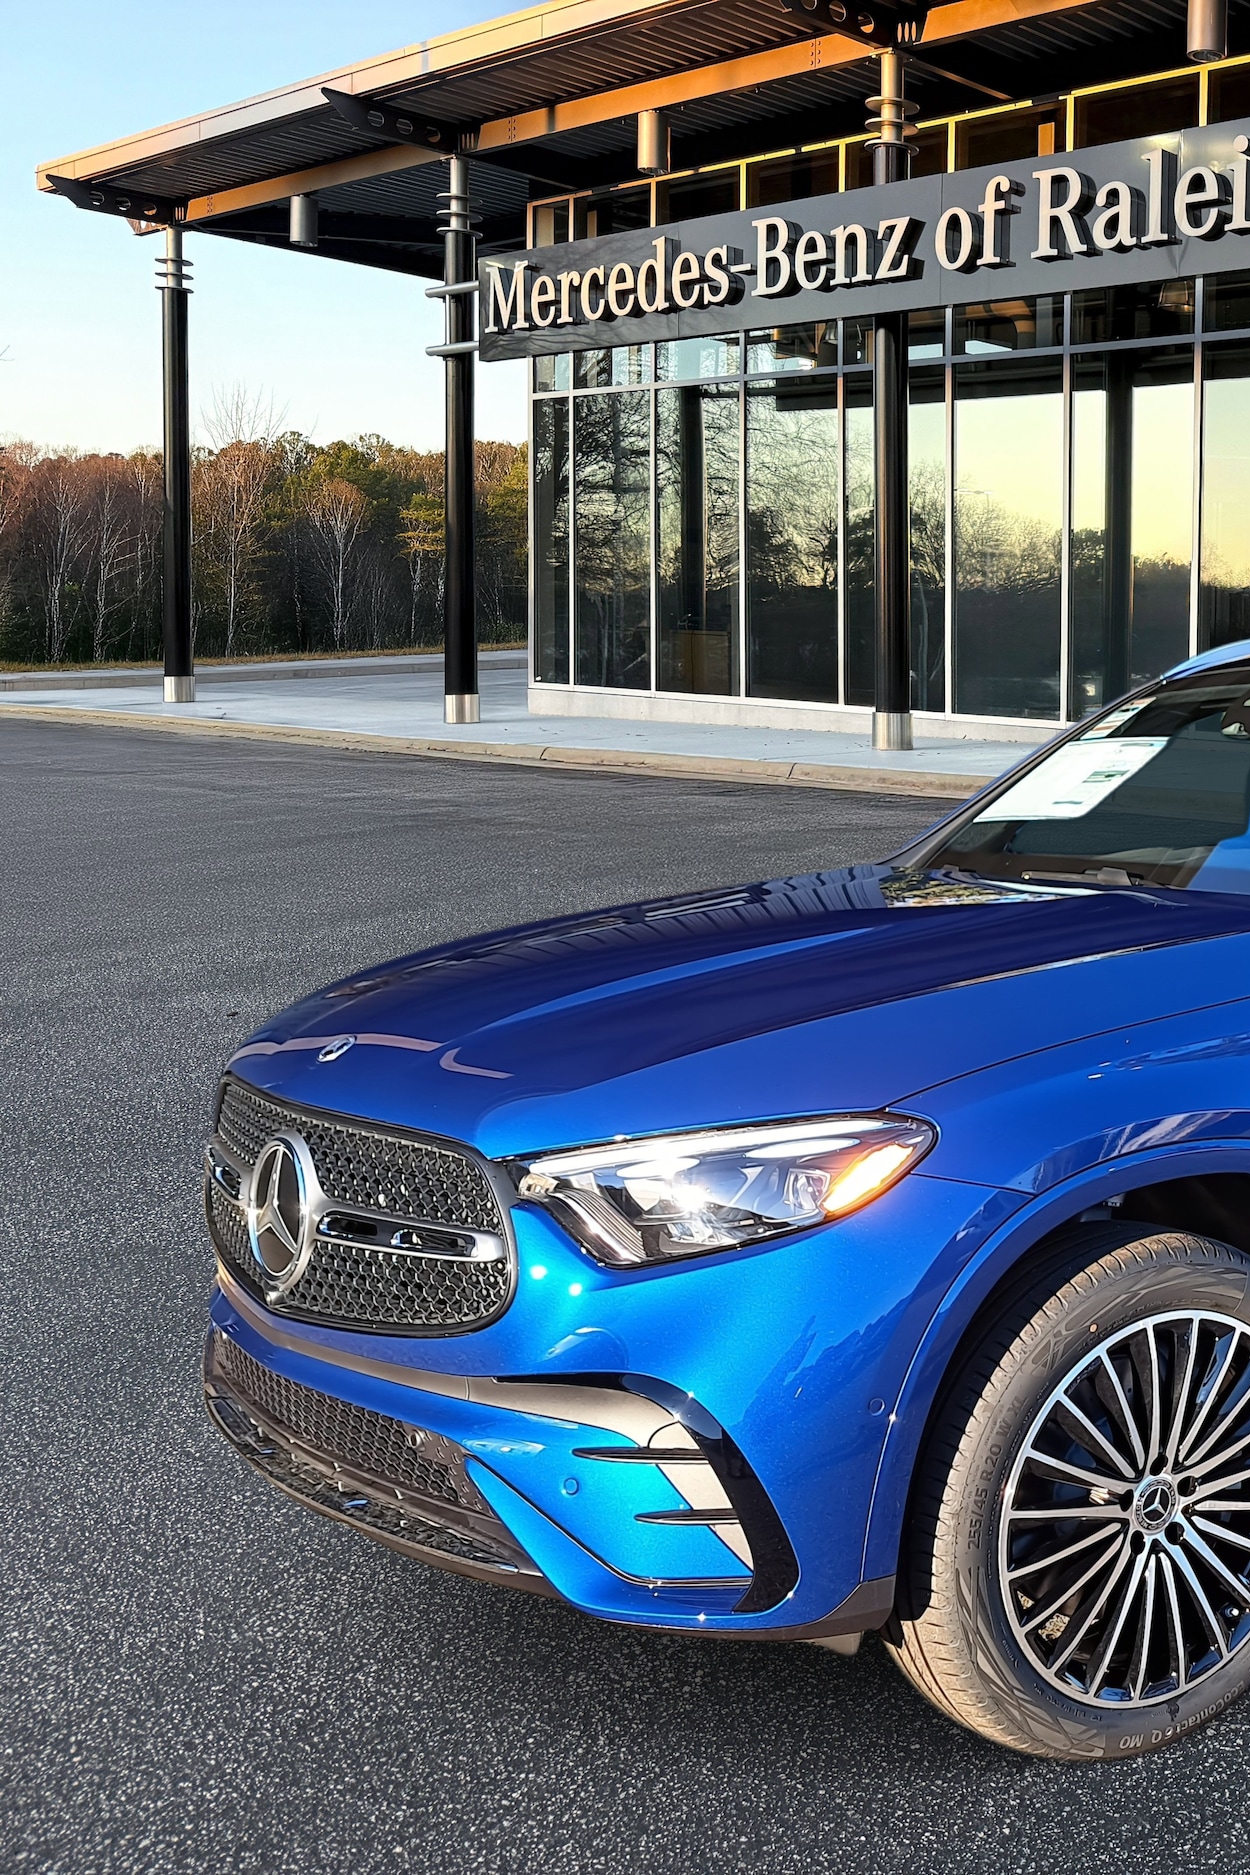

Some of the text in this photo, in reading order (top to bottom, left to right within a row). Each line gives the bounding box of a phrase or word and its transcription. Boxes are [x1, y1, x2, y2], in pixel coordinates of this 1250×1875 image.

[485, 216, 912, 334] Mercedes-Benz
[935, 175, 1011, 271] of
[967, 1486, 989, 1551] 255/45
